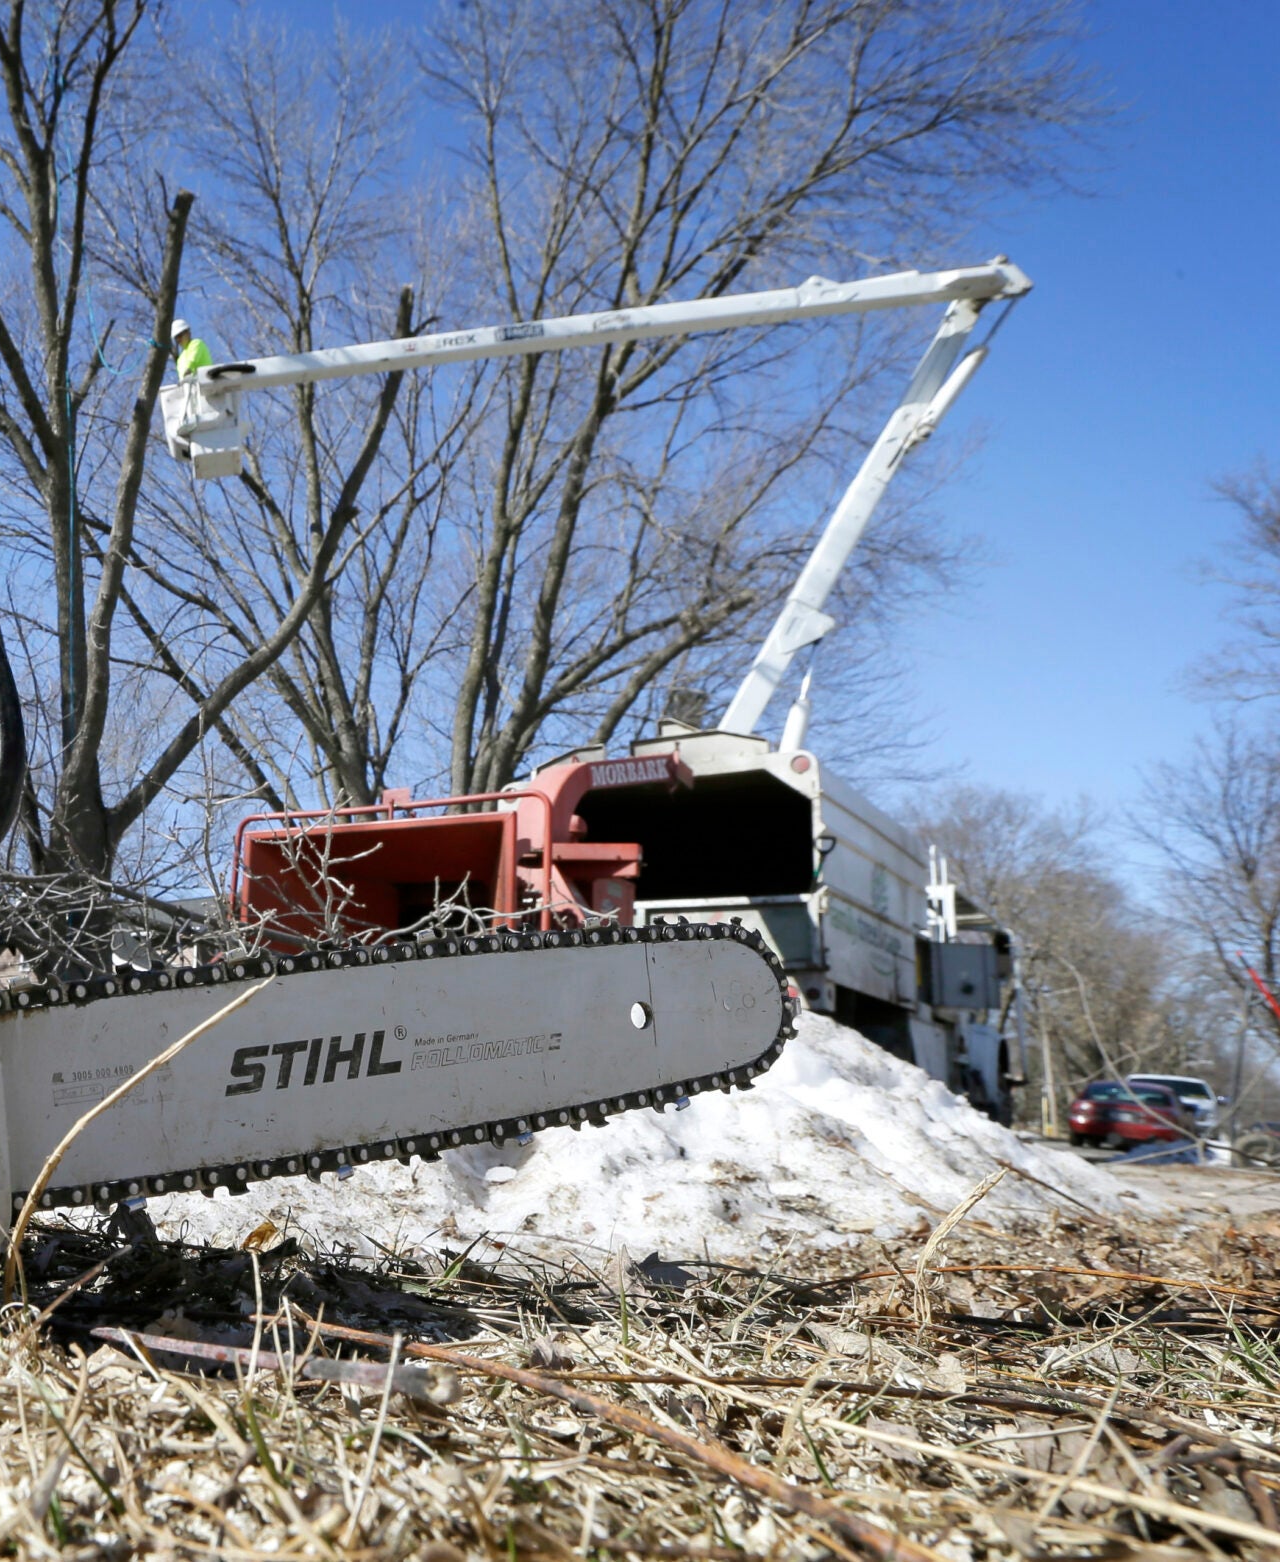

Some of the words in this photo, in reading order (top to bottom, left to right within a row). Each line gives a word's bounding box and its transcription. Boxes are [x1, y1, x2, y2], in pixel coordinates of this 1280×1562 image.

[591, 758, 670, 787] MORBARK
[414, 1036, 436, 1047] Made
[437, 1035, 445, 1044] in
[446, 1032, 480, 1044] Germany
[411, 1035, 546, 1071] ROLLOMATIC
[72, 1070, 93, 1081] 3005
